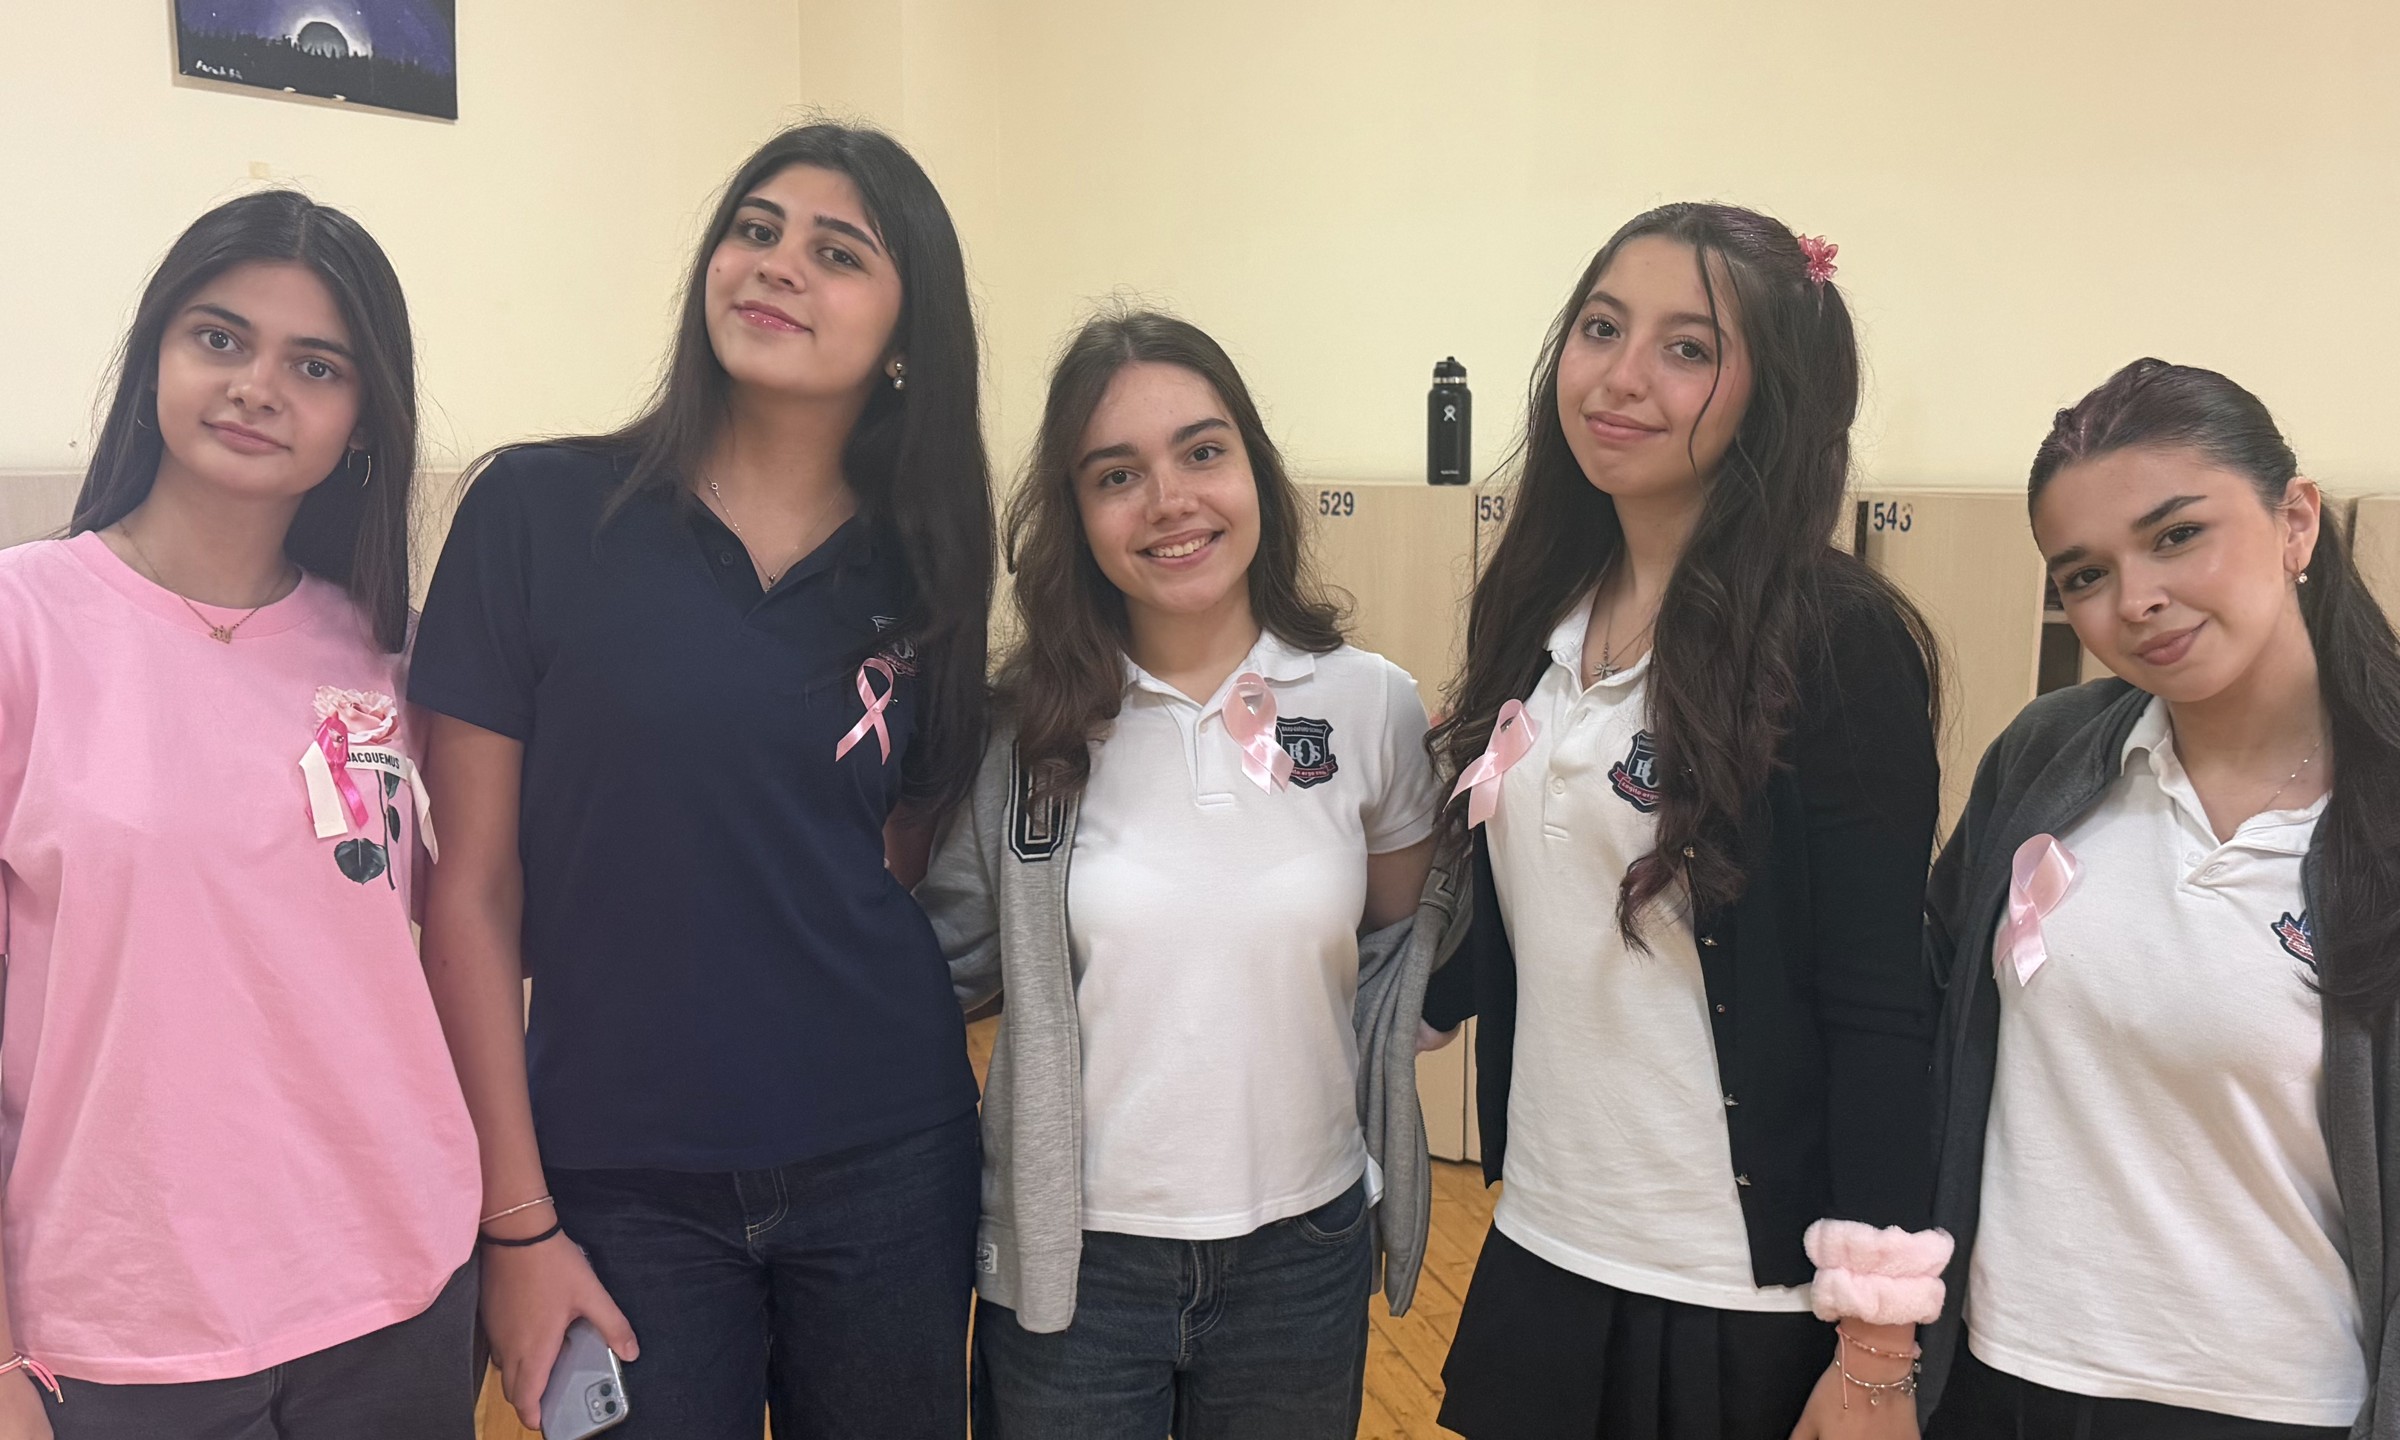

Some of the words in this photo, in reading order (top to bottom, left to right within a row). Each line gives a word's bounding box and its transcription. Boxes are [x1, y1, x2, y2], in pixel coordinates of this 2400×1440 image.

[1319, 491, 1354, 516] 529
[1480, 496, 1504, 521] 53
[1873, 501, 1913, 531] 543
[346, 752, 400, 770] JACQUEMUS
[1286, 738, 1321, 767] BOS
